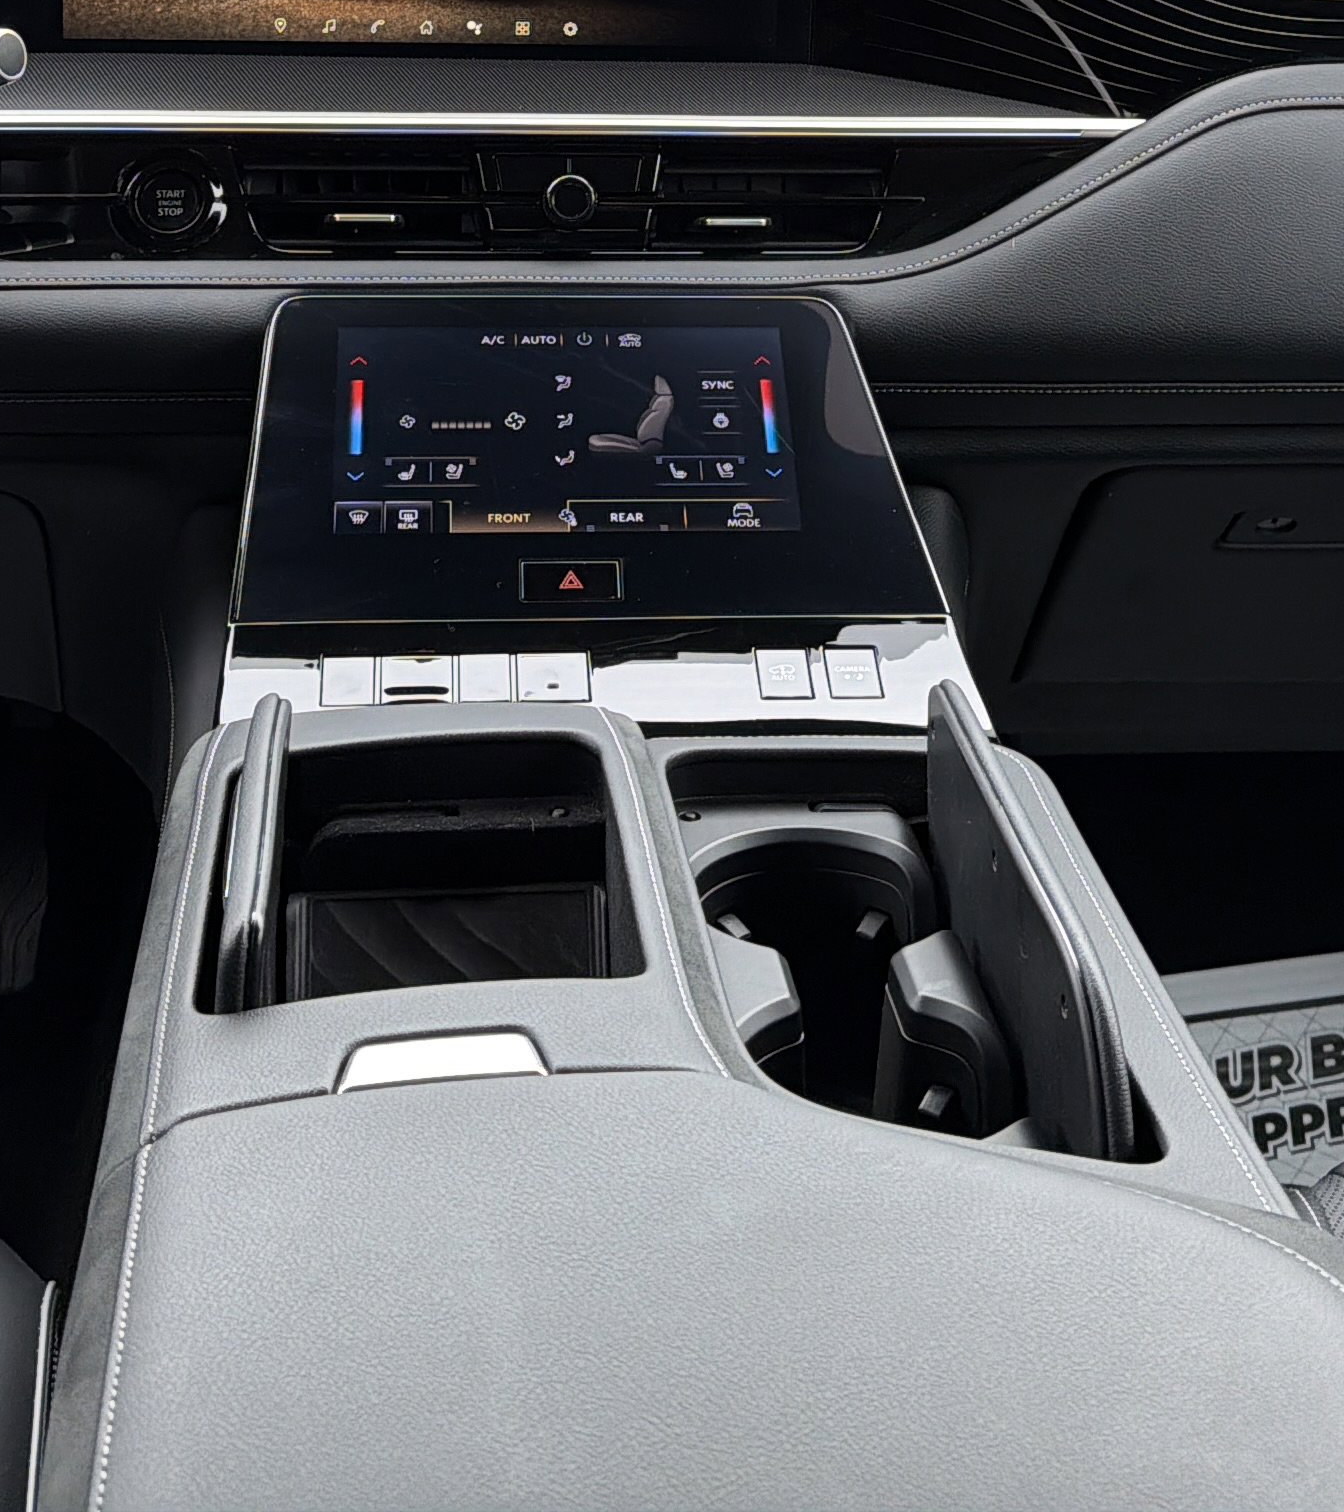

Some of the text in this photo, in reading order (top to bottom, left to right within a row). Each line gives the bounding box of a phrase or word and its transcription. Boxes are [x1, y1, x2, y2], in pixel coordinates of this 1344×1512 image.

[156, 189, 185, 199] START
[157, 207, 184, 217] STOP
[481, 335, 557, 345] A/C AUTO
[619, 340, 642, 348] AUTO
[701, 380, 735, 390] SYNC
[487, 513, 531, 523] FRONT
[610, 512, 644, 523] REAR
[397, 522, 419, 530] REAR
[727, 518, 761, 528] MODE
[834, 665, 871, 673] CAMERA
